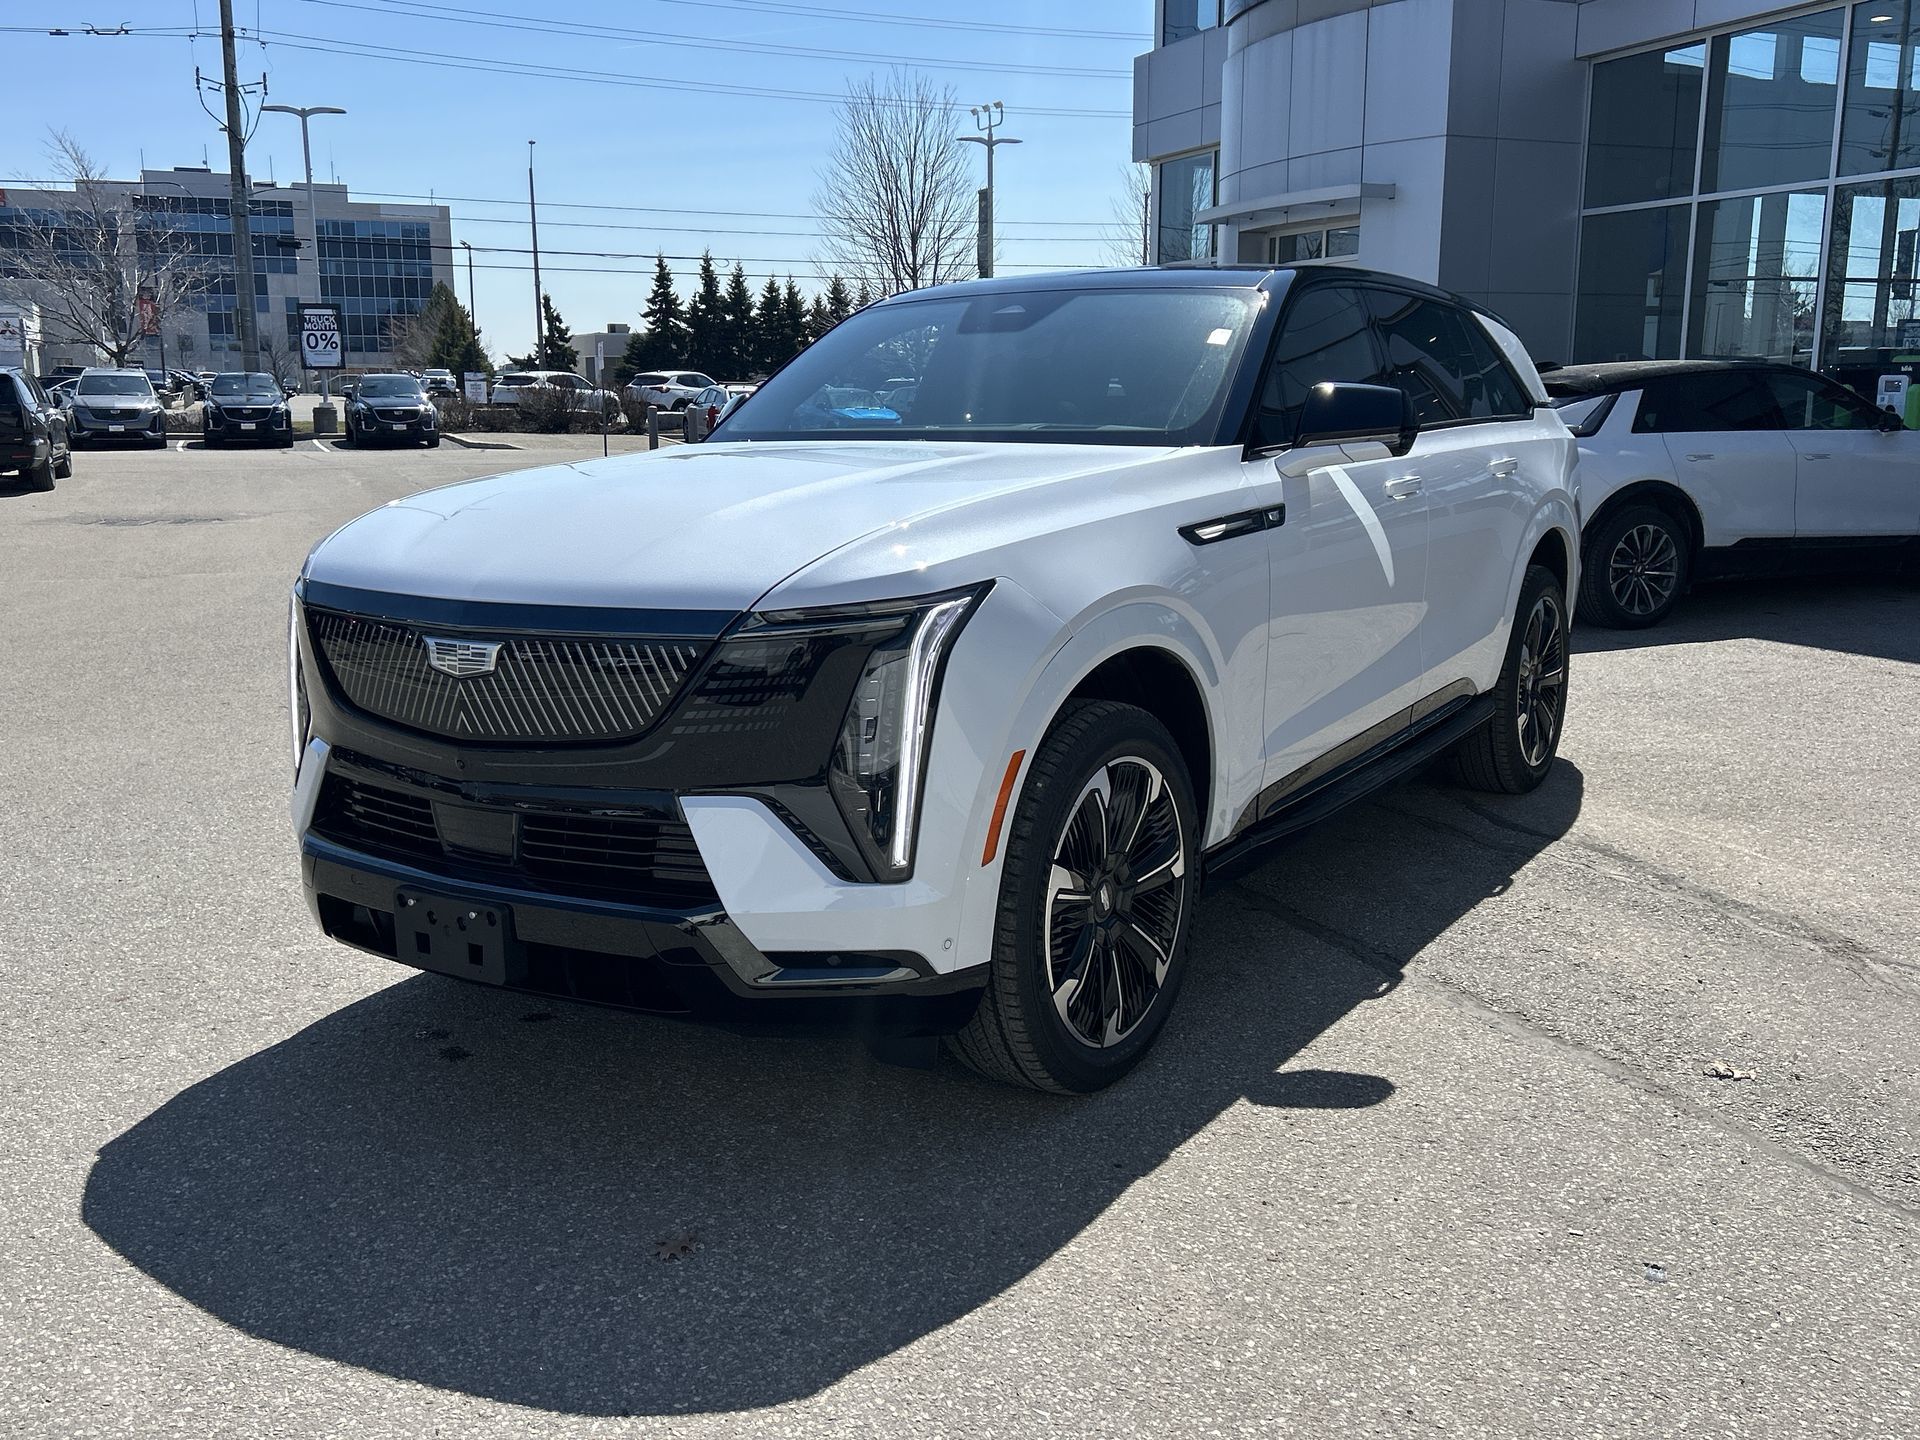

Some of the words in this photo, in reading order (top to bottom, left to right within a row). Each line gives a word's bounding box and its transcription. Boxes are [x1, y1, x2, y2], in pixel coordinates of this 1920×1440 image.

[304, 315, 336, 323] TRUCK
[304, 322, 338, 330] MONTH
[306, 333, 339, 350] 0%
